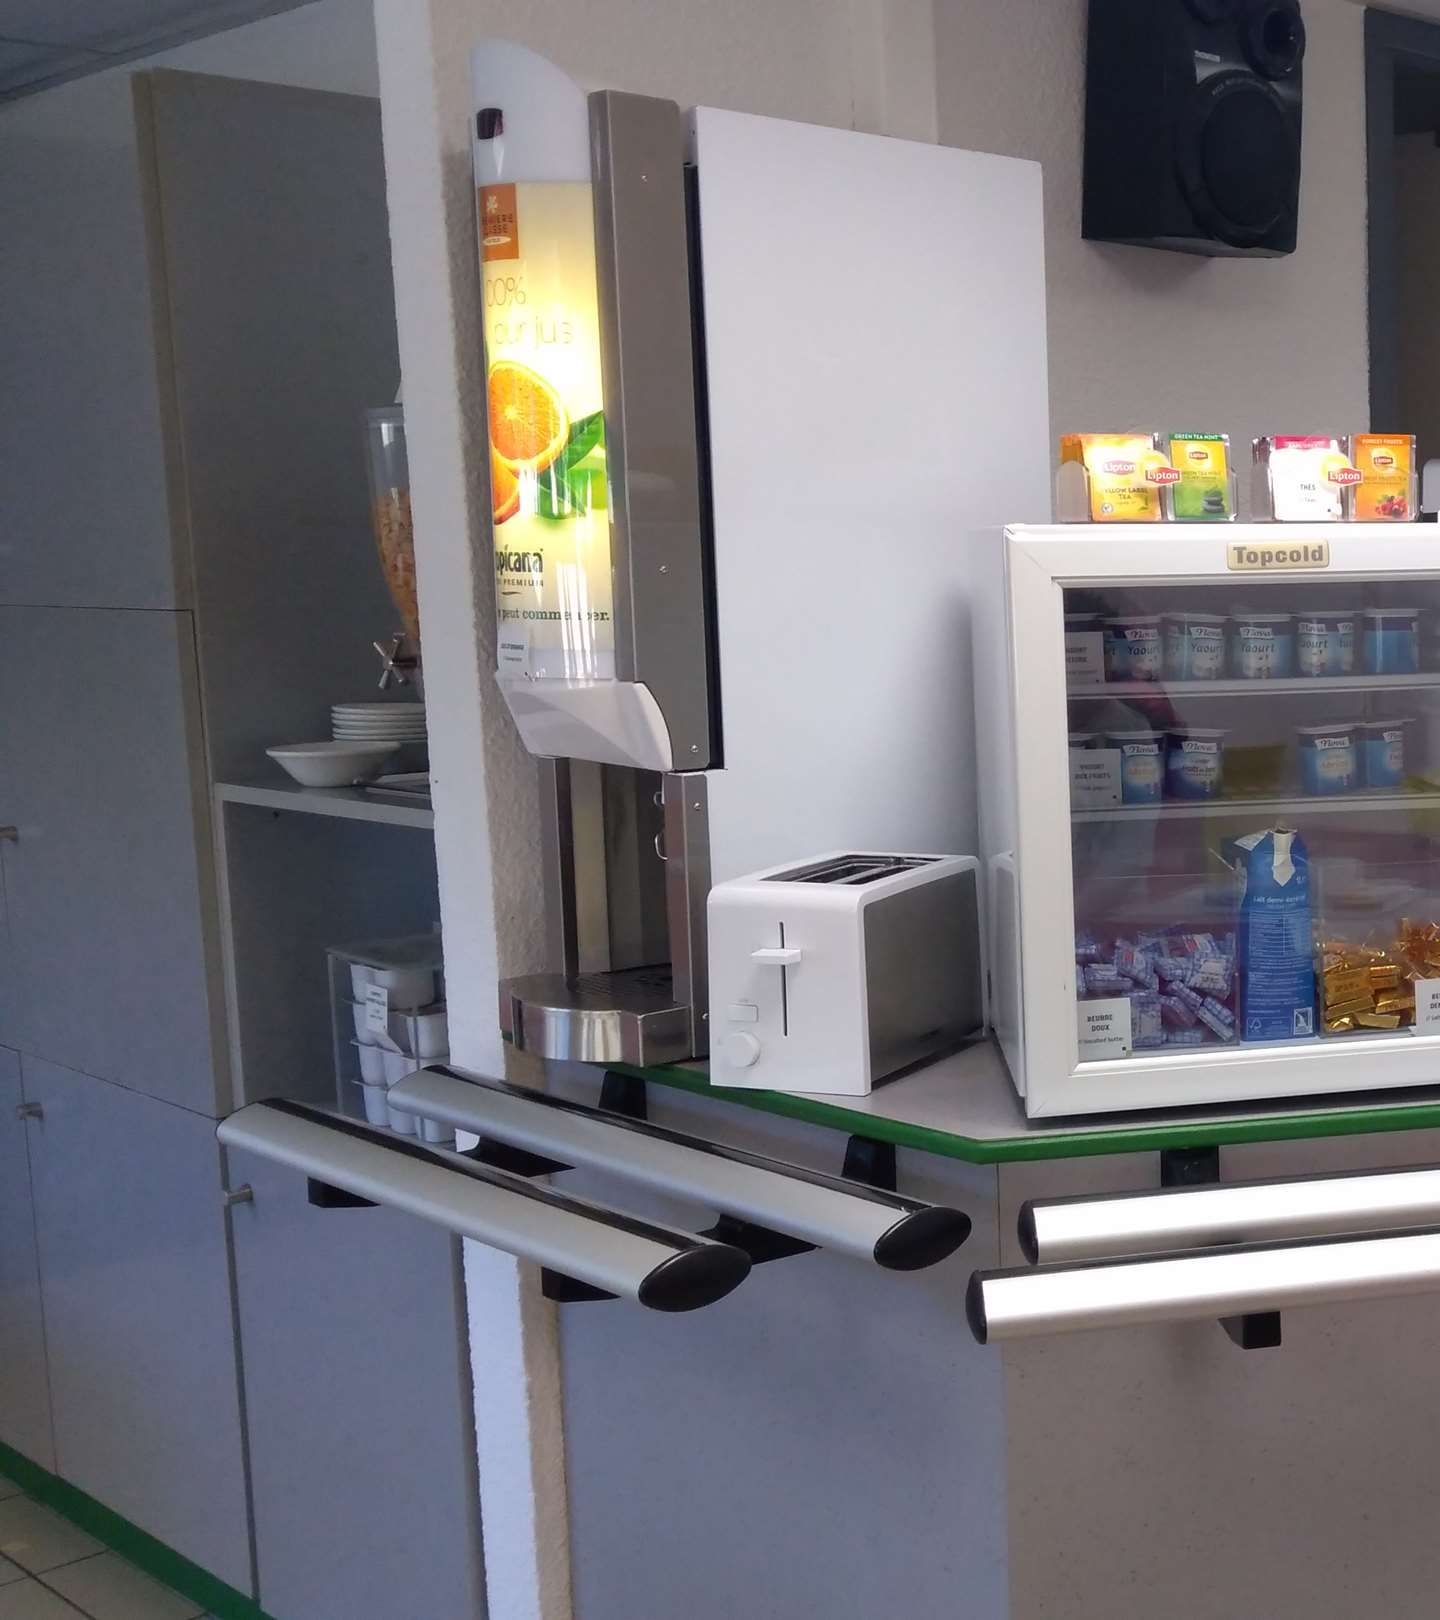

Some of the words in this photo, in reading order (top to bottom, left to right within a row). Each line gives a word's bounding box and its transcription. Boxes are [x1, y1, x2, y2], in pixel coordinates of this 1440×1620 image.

[1104, 463, 1136, 474] Lipton
[1147, 470, 1179, 481] Lipton
[1329, 470, 1361, 481] Lipton
[1232, 545, 1324, 567] Topcold
[1091, 1024, 1110, 1032] DOUX
